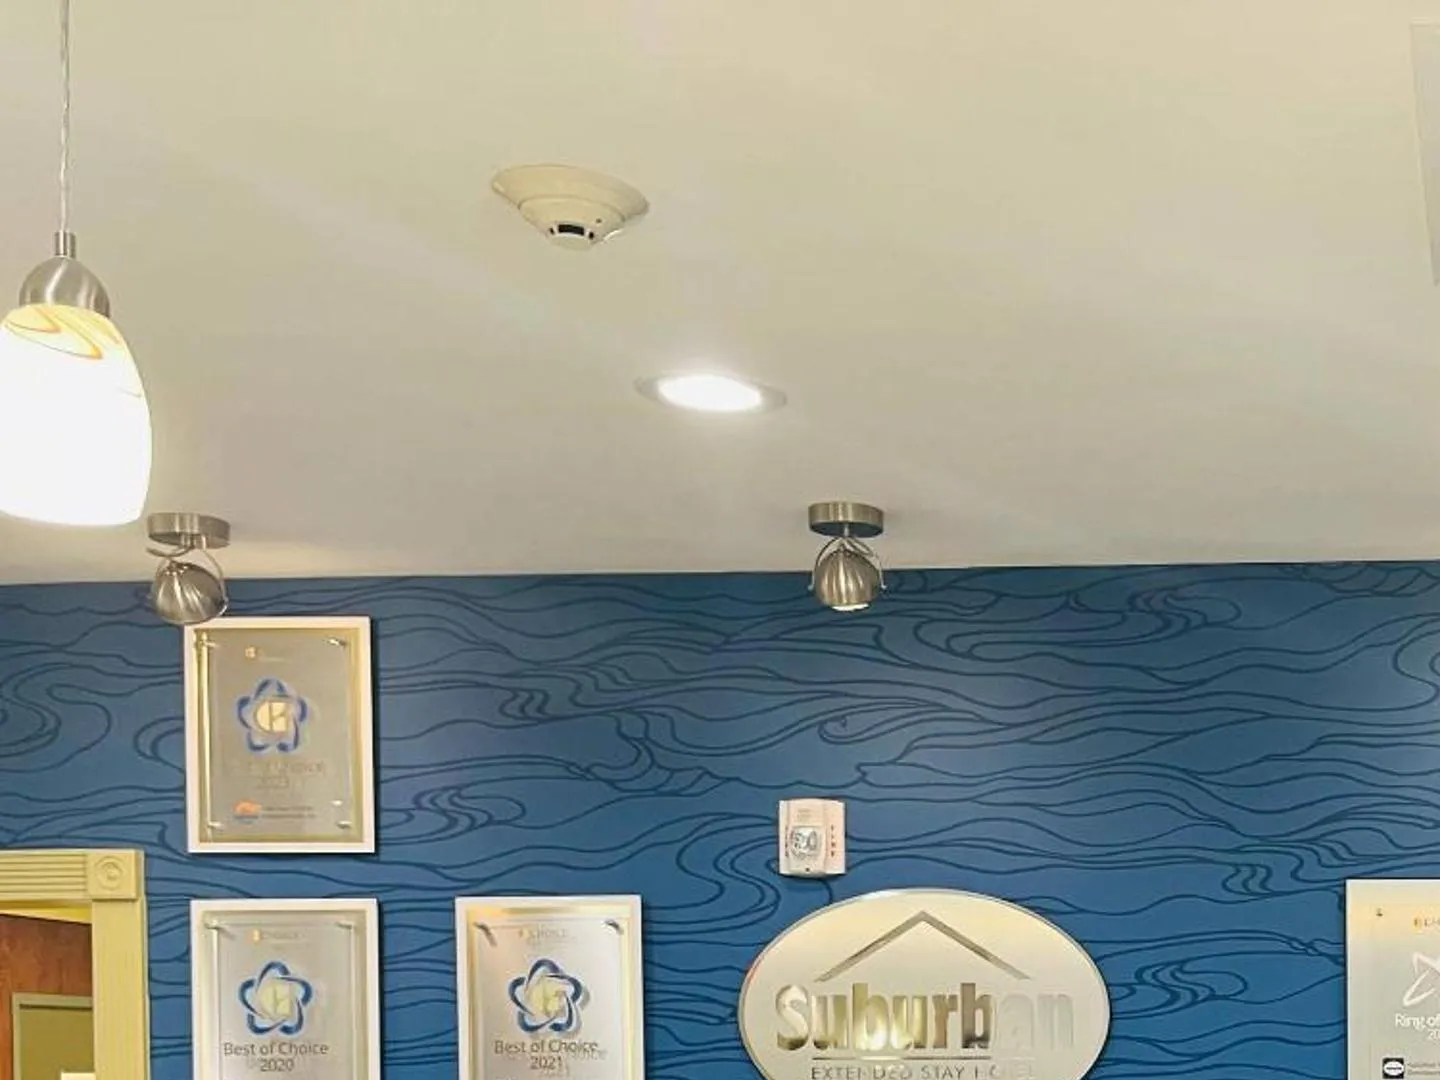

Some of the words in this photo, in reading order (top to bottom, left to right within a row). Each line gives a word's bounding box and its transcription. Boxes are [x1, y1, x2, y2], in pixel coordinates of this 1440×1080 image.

[775, 982, 1075, 1051] Suburban
[1395, 1013, 1425, 1030] Ring
[224, 1042, 256, 1057] Best
[260, 1041, 276, 1056] of
[278, 1041, 330, 1056] Choice
[494, 1040, 526, 1055] Best
[530, 1039, 545, 1053] of
[548, 1038, 599, 1054] Choice
[259, 1058, 295, 1072] 2020
[529, 1056, 563, 1070] 2021
[920, 1064, 966, 1080] STAY
